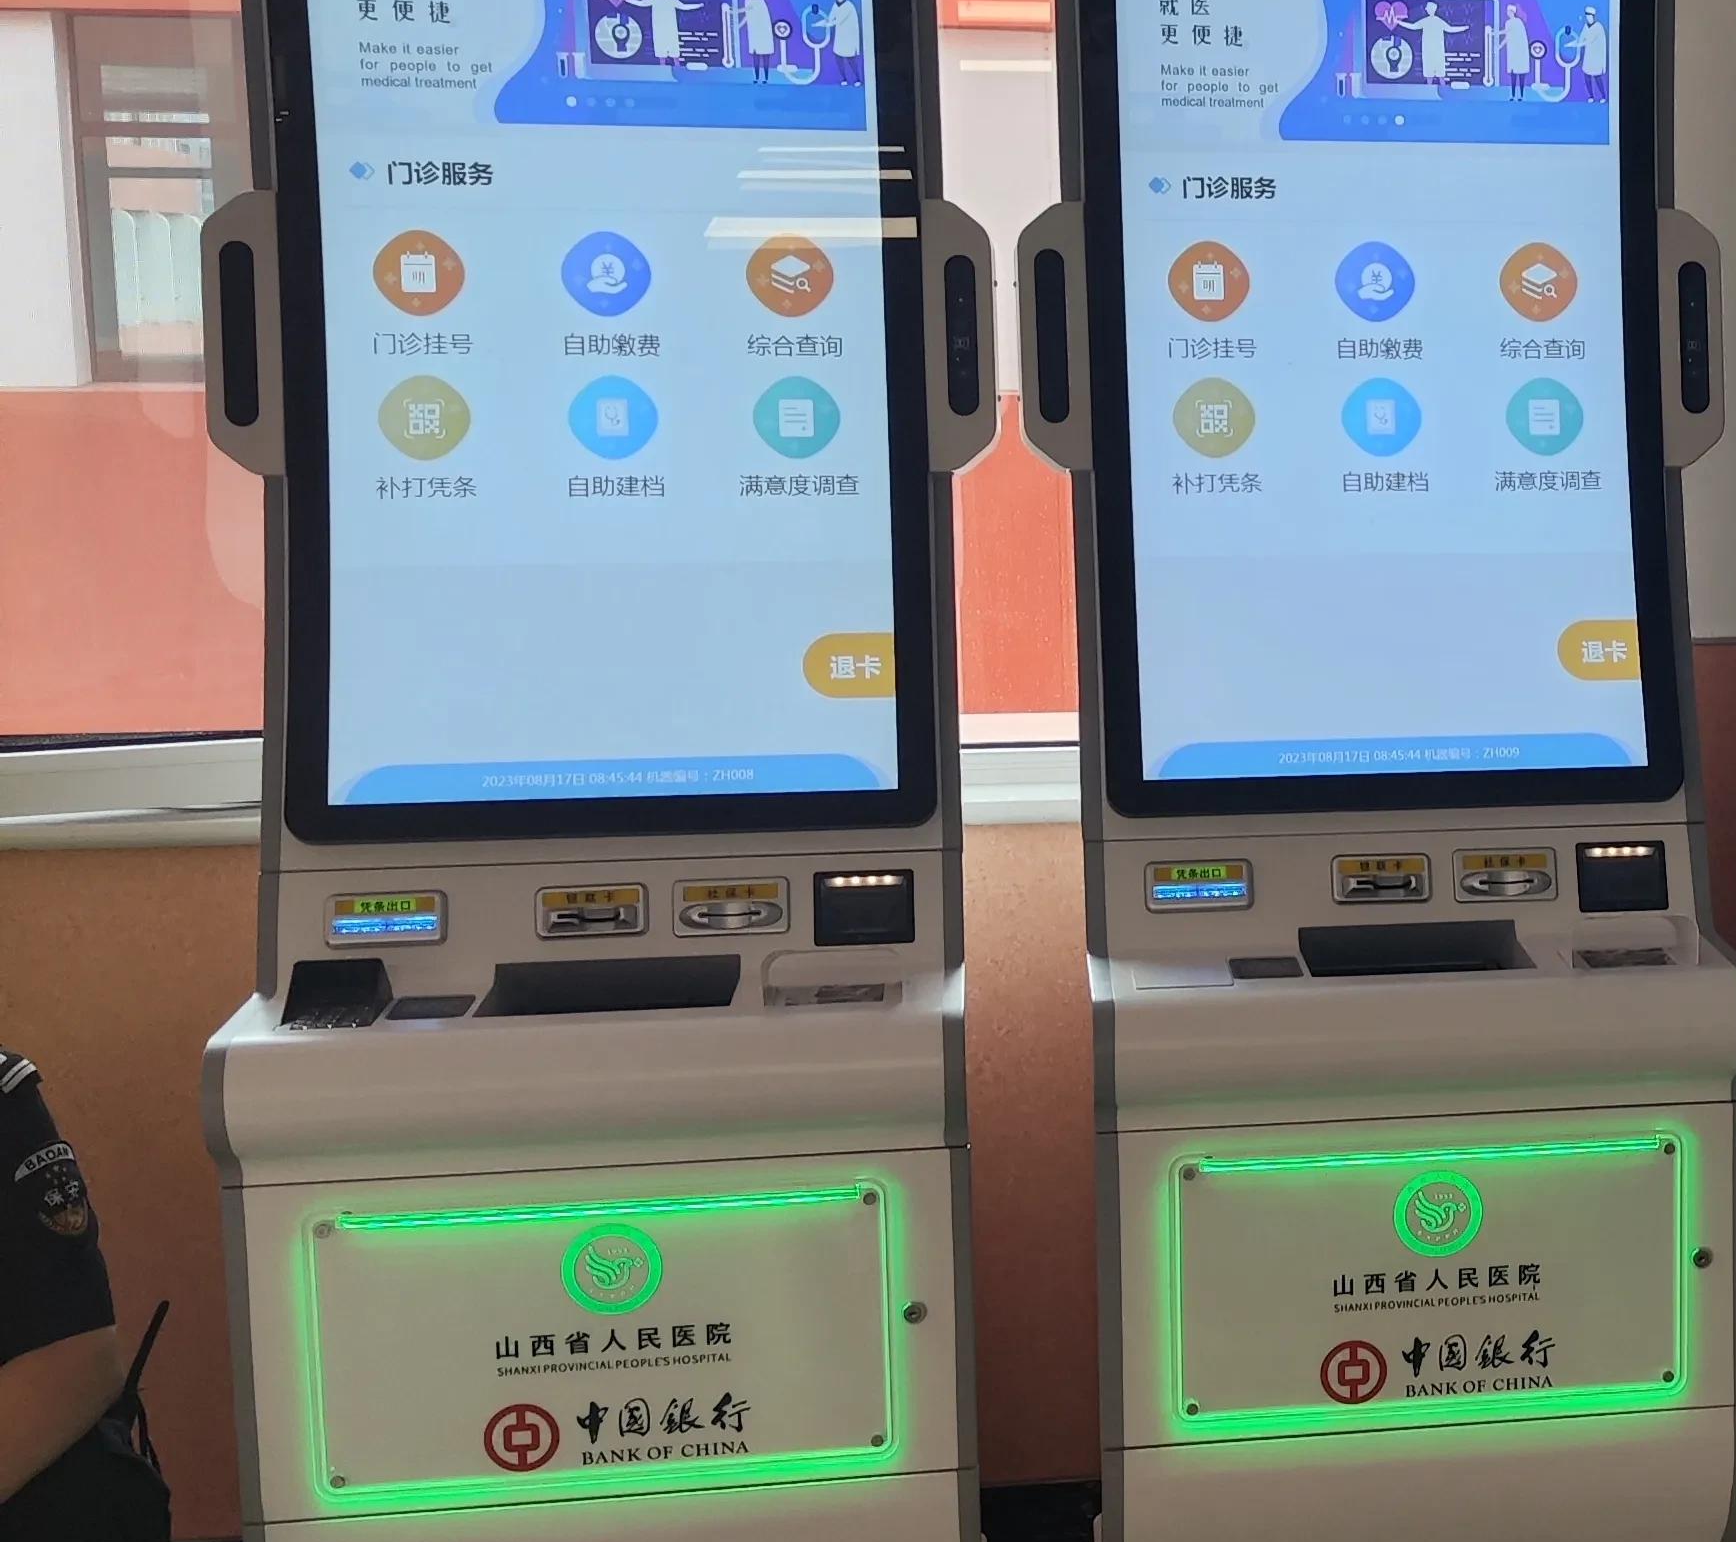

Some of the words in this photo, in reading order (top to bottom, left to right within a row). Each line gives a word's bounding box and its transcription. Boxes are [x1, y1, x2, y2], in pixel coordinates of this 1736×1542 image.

[357, 0, 451, 24] 更便捷
[1160, 25, 1244, 48] 更便捷
[359, 41, 397, 55] Make
[403, 42, 413, 56] it
[416, 43, 459, 56] easier
[360, 59, 378, 72] for
[390, 59, 437, 76] people
[447, 61, 461, 73] to
[471, 62, 493, 76] get
[1161, 64, 1194, 77] Make
[1211, 66, 1250, 78] easier
[361, 74, 412, 88] medical
[414, 76, 477, 90] treatment
[1160, 80, 1178, 93] for
[1187, 81, 1228, 96] people
[1238, 82, 1251, 94] to
[1259, 83, 1279, 97] get
[1161, 96, 1206, 109] medical
[1209, 97, 1264, 109] treatment
[387, 161, 494, 187] 门诊服务
[1182, 176, 1277, 201] 门诊服务
[373, 332, 473, 356] 门诊挂号
[563, 333, 661, 357] 自助缴费
[747, 333, 843, 358] 综合查询
[1168, 338, 1257, 360] 门诊挂号
[1336, 338, 1423, 360] 自助缴费
[1500, 338, 1585, 360] 综合查询
[376, 475, 477, 499] 补打凭条
[568, 475, 665, 499] 自助建档
[739, 474, 859, 498] 满意度调查
[1172, 472, 1263, 494] 补打凭条
[1342, 472, 1429, 493] 自助建档
[1495, 469, 1602, 492] 满意度调查
[1581, 640, 1627, 663] 退卡
[830, 655, 881, 680] 退卡
[1177, 866, 1222, 880] 凭条出口
[360, 899, 412, 913] 凭条出口
[1333, 1263, 1541, 1297] 山西省人民医院
[1334, 1302, 1373, 1313] SHANXI
[1375, 1298, 1435, 1310] PROVINCIAL
[1489, 1292, 1540, 1304] HOSPITAL
[496, 1322, 731, 1359] 山西省人民医院
[497, 1364, 540, 1377] SHANXI
[543, 1360, 613, 1374] PROVINCIAL
[673, 1352, 731, 1365] HOSPITAL
[1406, 1381, 1458, 1397] BANK
[1463, 1379, 1486, 1393] OF
[1493, 1376, 1553, 1391] CHINA
[582, 1449, 641, 1465] BANK
[647, 1446, 673, 1459] OF
[681, 1440, 750, 1457] CHINA
